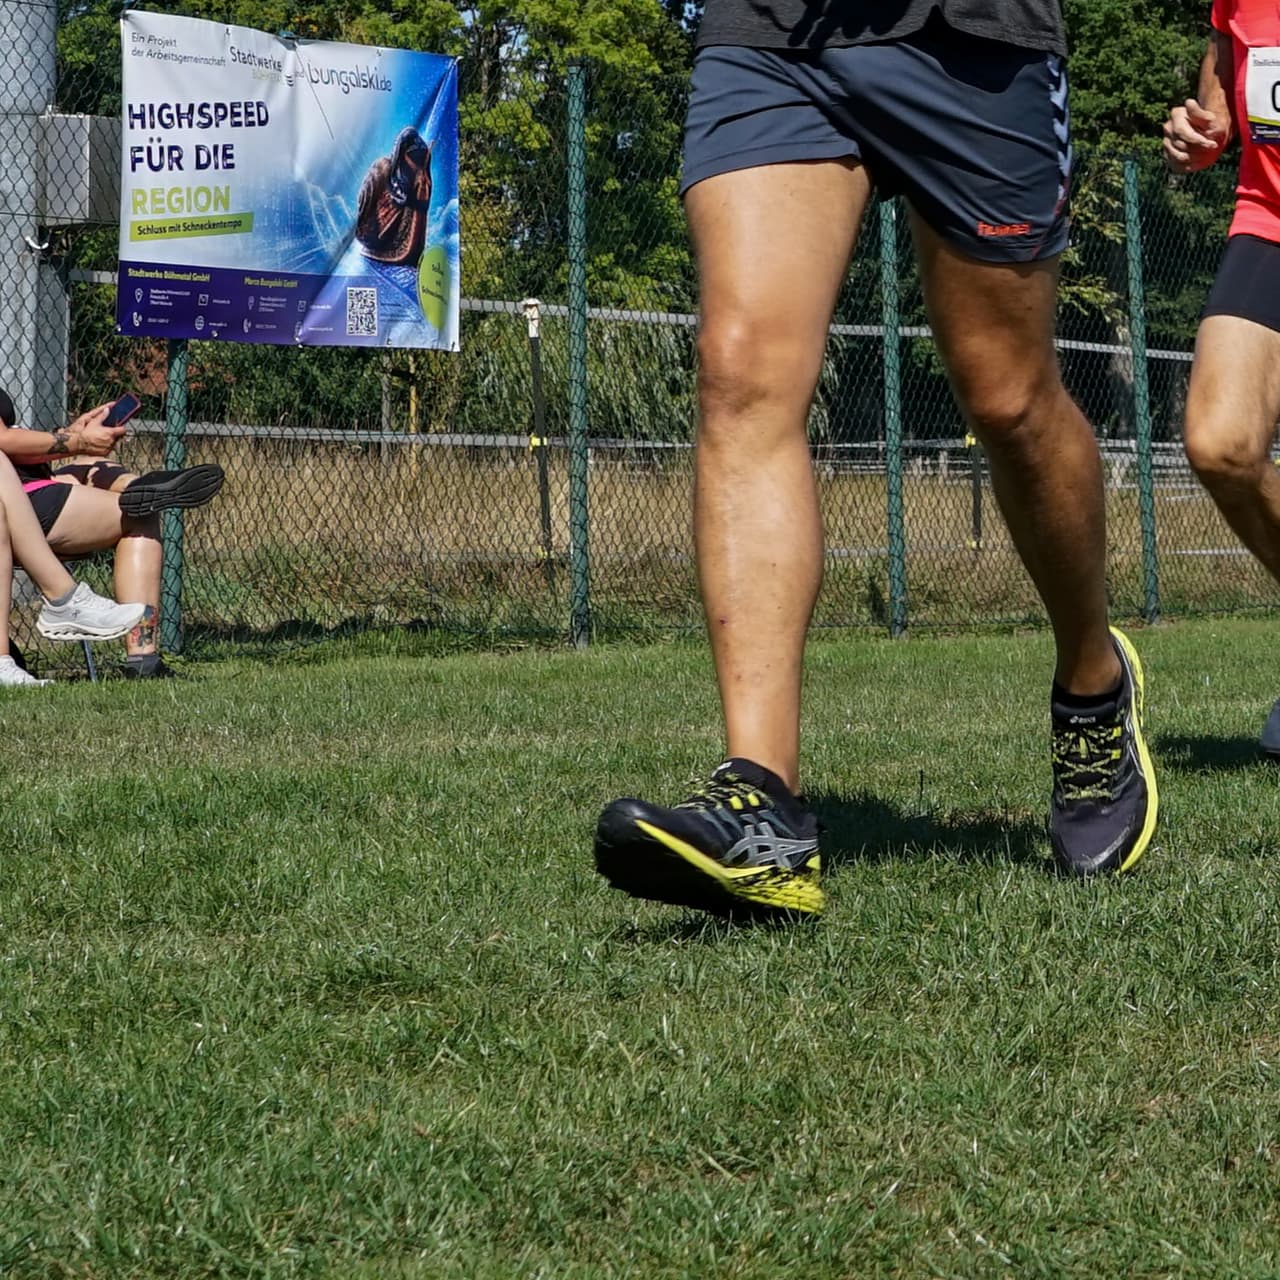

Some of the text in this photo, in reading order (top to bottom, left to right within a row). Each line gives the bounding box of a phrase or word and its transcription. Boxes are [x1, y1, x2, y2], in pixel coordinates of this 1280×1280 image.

[131, 32, 177, 48] Ein Projekt
[131, 47, 226, 67] der Arbeitsgemeinschaft
[229, 45, 283, 71] Stadtwerke
[307, 63, 392, 94] bungalski.de
[127, 100, 269, 130] HIGHSPEED
[130, 136, 236, 173] FÜR DIE
[131, 185, 231, 216] REGION
[137, 219, 242, 236] Schluss mit Schneckentempo
